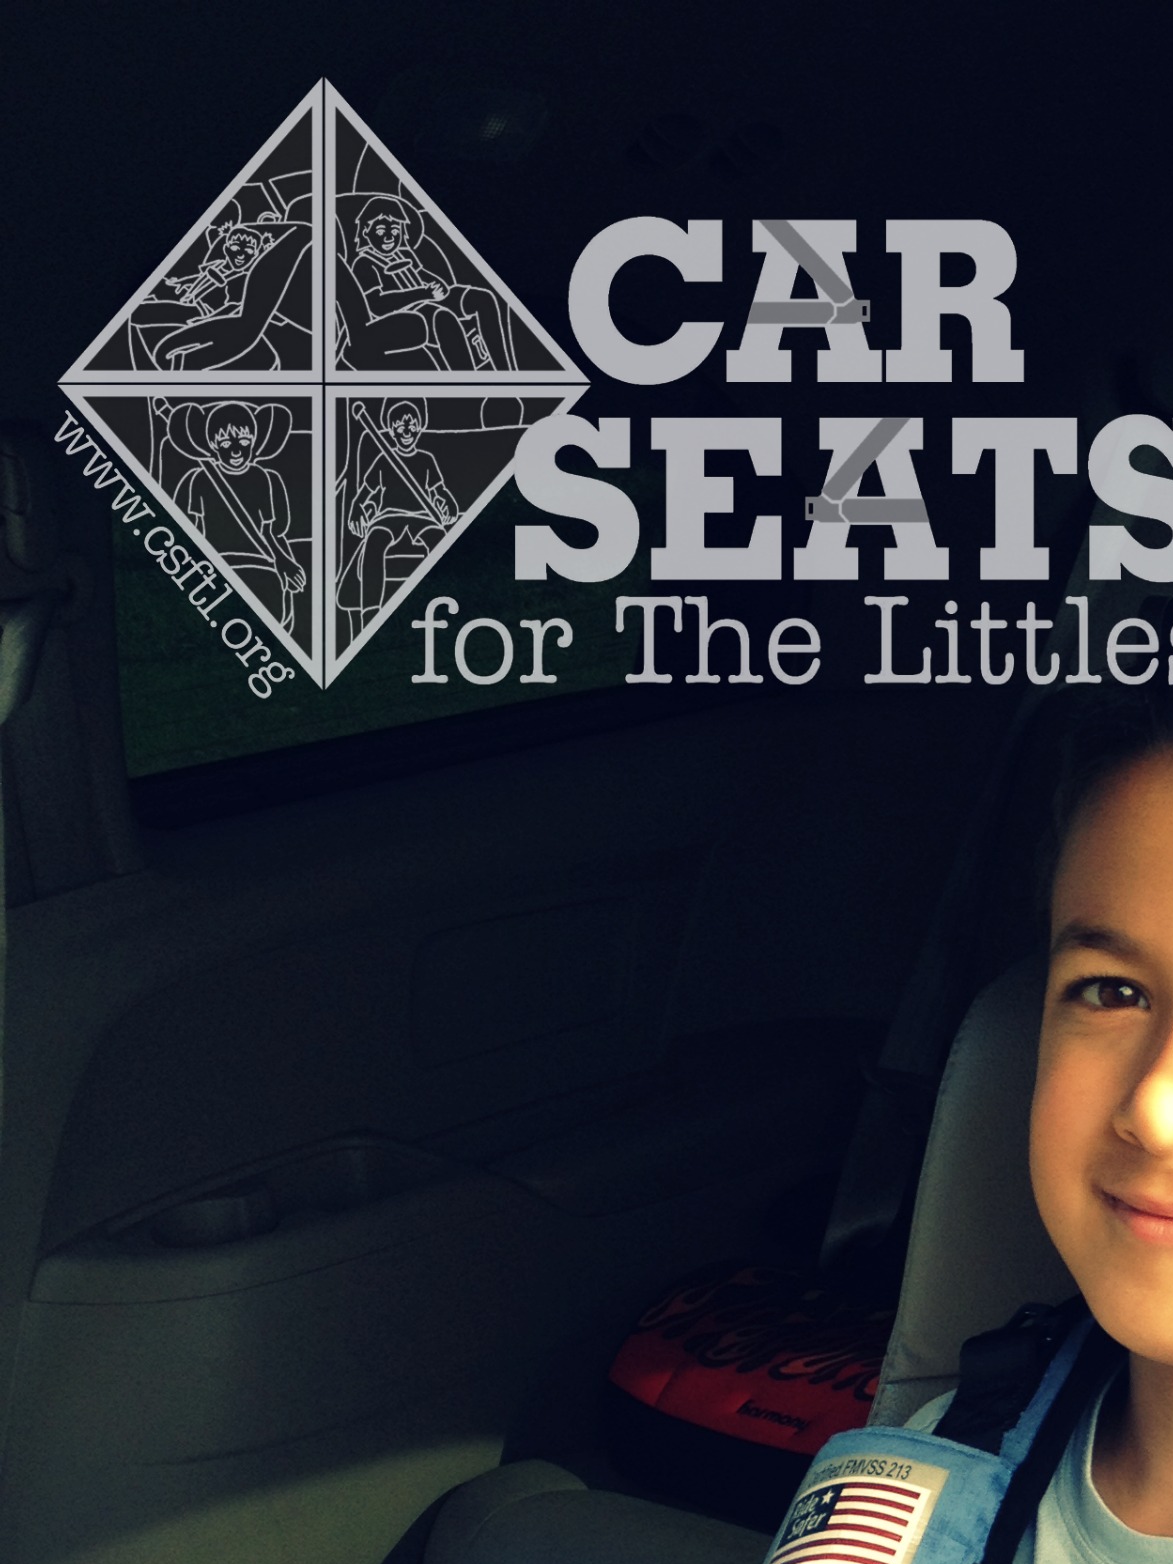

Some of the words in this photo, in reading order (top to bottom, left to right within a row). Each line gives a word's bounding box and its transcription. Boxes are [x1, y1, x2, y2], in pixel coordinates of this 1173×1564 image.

[736, 1398, 810, 1435] harmony
[842, 1458, 888, 1477] FMVSS
[886, 1461, 913, 1480] 213
[787, 1511, 828, 1540] Safer
